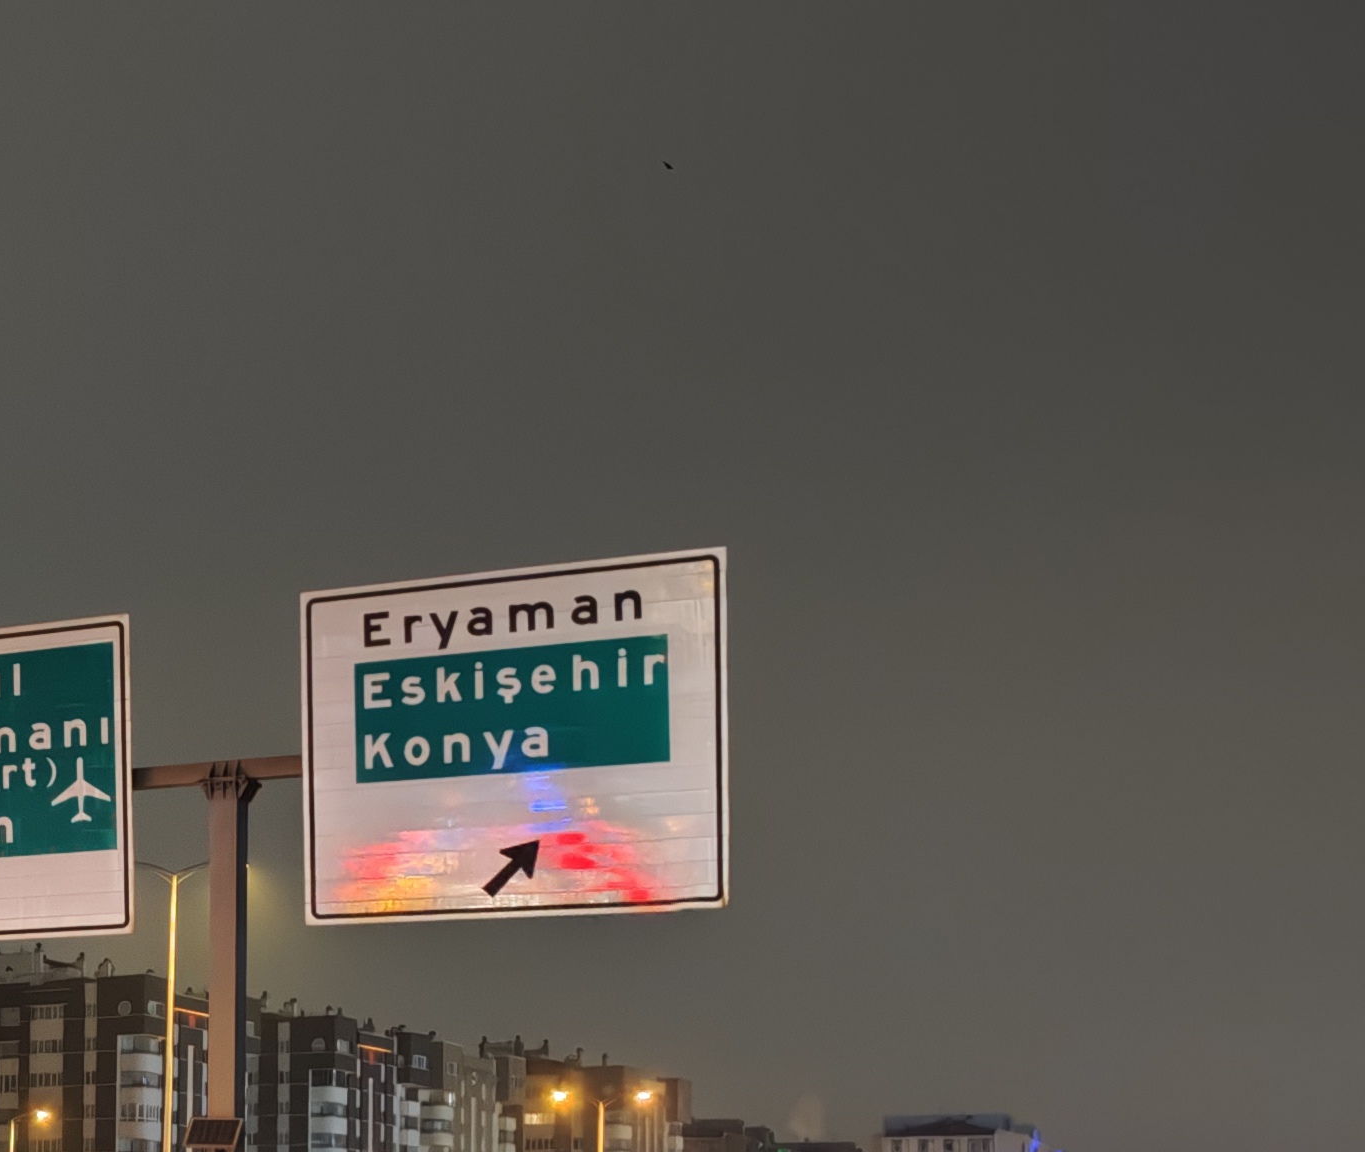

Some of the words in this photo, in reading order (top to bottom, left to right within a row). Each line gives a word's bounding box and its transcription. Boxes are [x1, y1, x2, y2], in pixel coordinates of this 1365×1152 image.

[363, 589, 643, 650] Eryaman
[363, 647, 666, 710] Eskişehir
[364, 726, 550, 770] Konya
